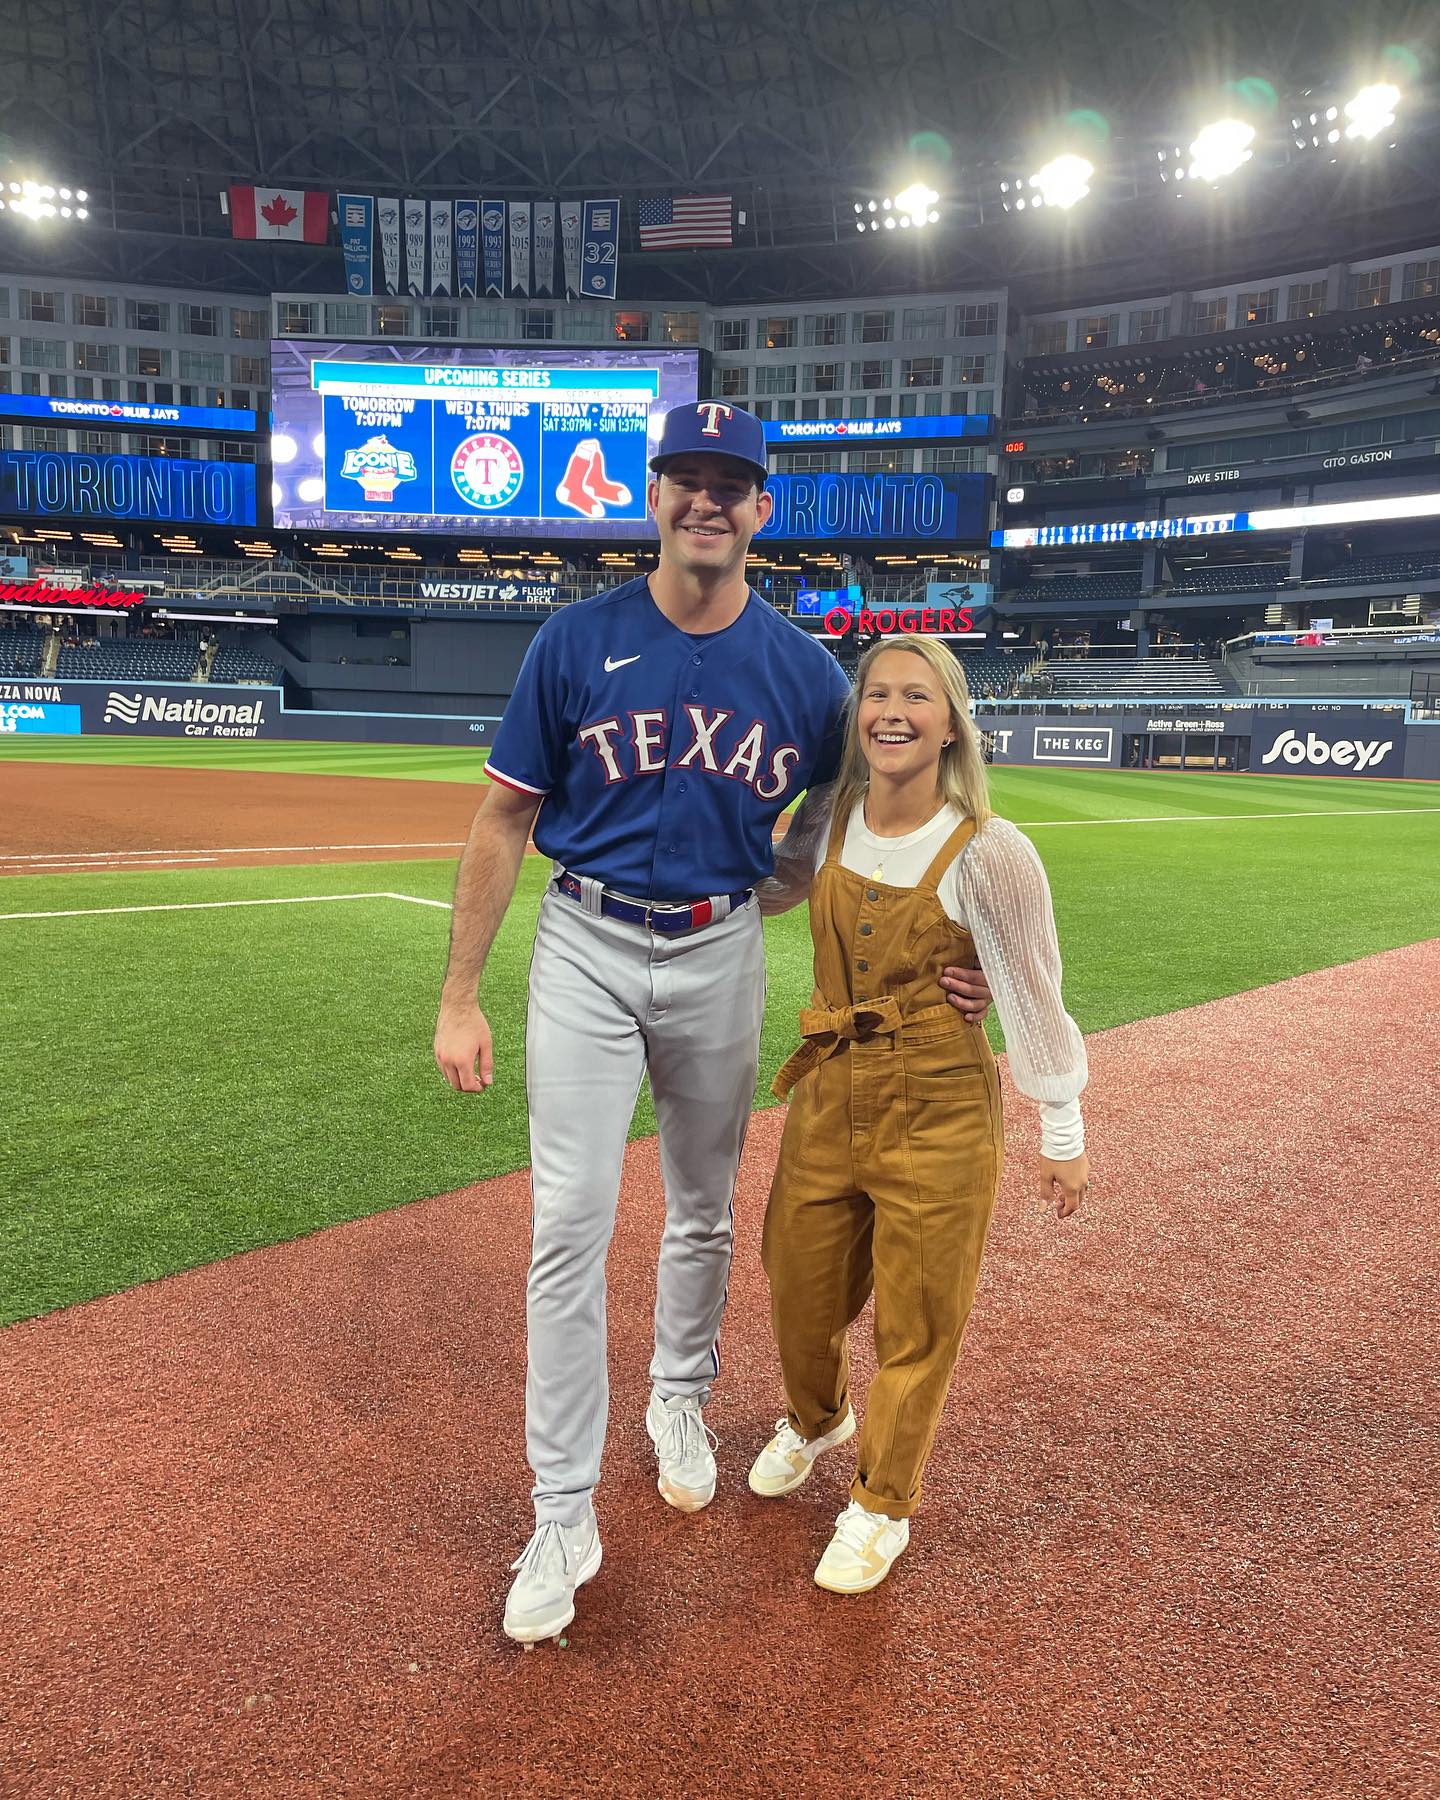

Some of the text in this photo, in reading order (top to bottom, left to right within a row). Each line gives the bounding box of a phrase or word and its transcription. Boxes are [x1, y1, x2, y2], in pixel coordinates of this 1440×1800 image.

[382, 233, 398, 246] 985
[433, 234, 449, 248] 1991
[458, 235, 476, 248] 1992
[484, 235, 502, 248] 1993
[511, 236, 529, 249] 2015
[536, 236, 553, 249] 2016
[584, 241, 616, 265] 32
[424, 368, 551, 388] UPCOMING SERIES
[49, 400, 180, 420] TORONTO BLUE JAYS
[341, 396, 415, 414] TOMORROW
[445, 400, 530, 417] WED & THURS
[543, 402, 647, 418] FRIDAY 7:07PM
[355, 411, 403, 428] 7:07PM
[464, 415, 511, 431] 7:07PM
[543, 418, 647, 432] SAT 3:07PM SUN 1:37PM
[696, 402, 733, 437] T
[780, 420, 902, 436] TORONTO BLUE JAYS
[461, 438, 513, 458] TEXAS
[342, 450, 417, 477] LOONIE
[1323, 450, 1393, 468] CITO GASTON
[475, 458, 498, 485] T
[1187, 470, 1240, 485] DAVE STIEB
[8, 453, 233, 521] TORONTO
[757, 475, 943, 535] ORONTO
[420, 583, 557, 602] WESTJET FLIGHT
[526, 596, 552, 604] DECK
[858, 607, 974, 633] ROGERS
[25, 686, 61, 702] NOVA
[184, 724, 258, 737] Car Rental
[468, 723, 485, 732] 400
[1147, 719, 1173, 728] Active
[578, 704, 800, 801] TEXAS
[1043, 738, 1103, 751] THE KEG
[1262, 729, 1393, 771] Sobeys
